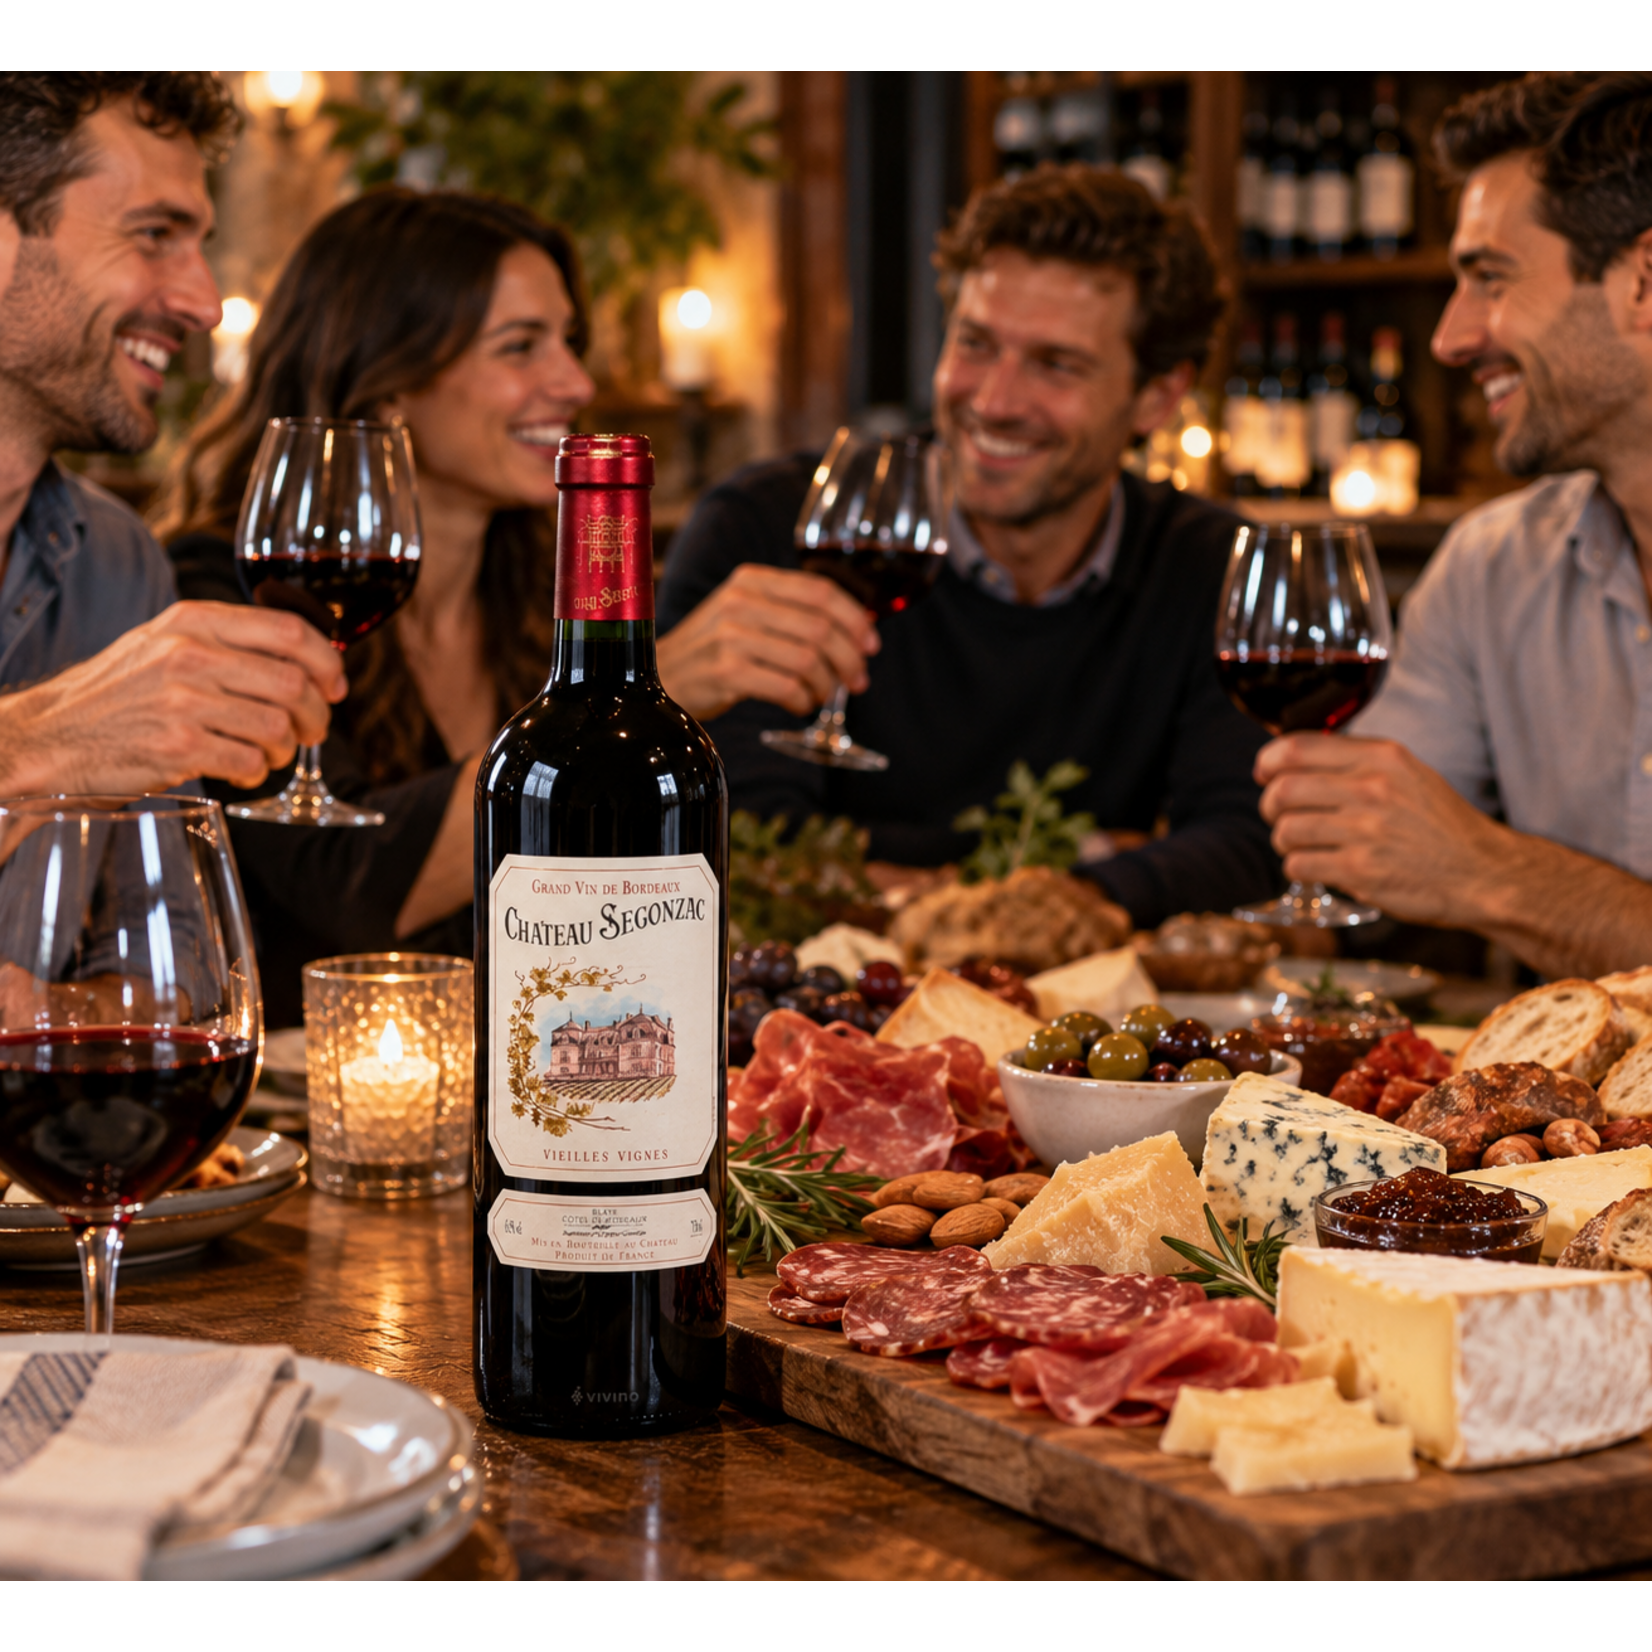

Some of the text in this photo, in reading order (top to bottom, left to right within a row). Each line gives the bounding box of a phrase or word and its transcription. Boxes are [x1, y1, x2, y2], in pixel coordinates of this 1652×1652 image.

[531, 879, 681, 895] GRAND VIN DE BORDEAUX
[599, 897, 705, 940] SEGONZAC
[543, 1149, 669, 1162] VIEILLES VIGNES
